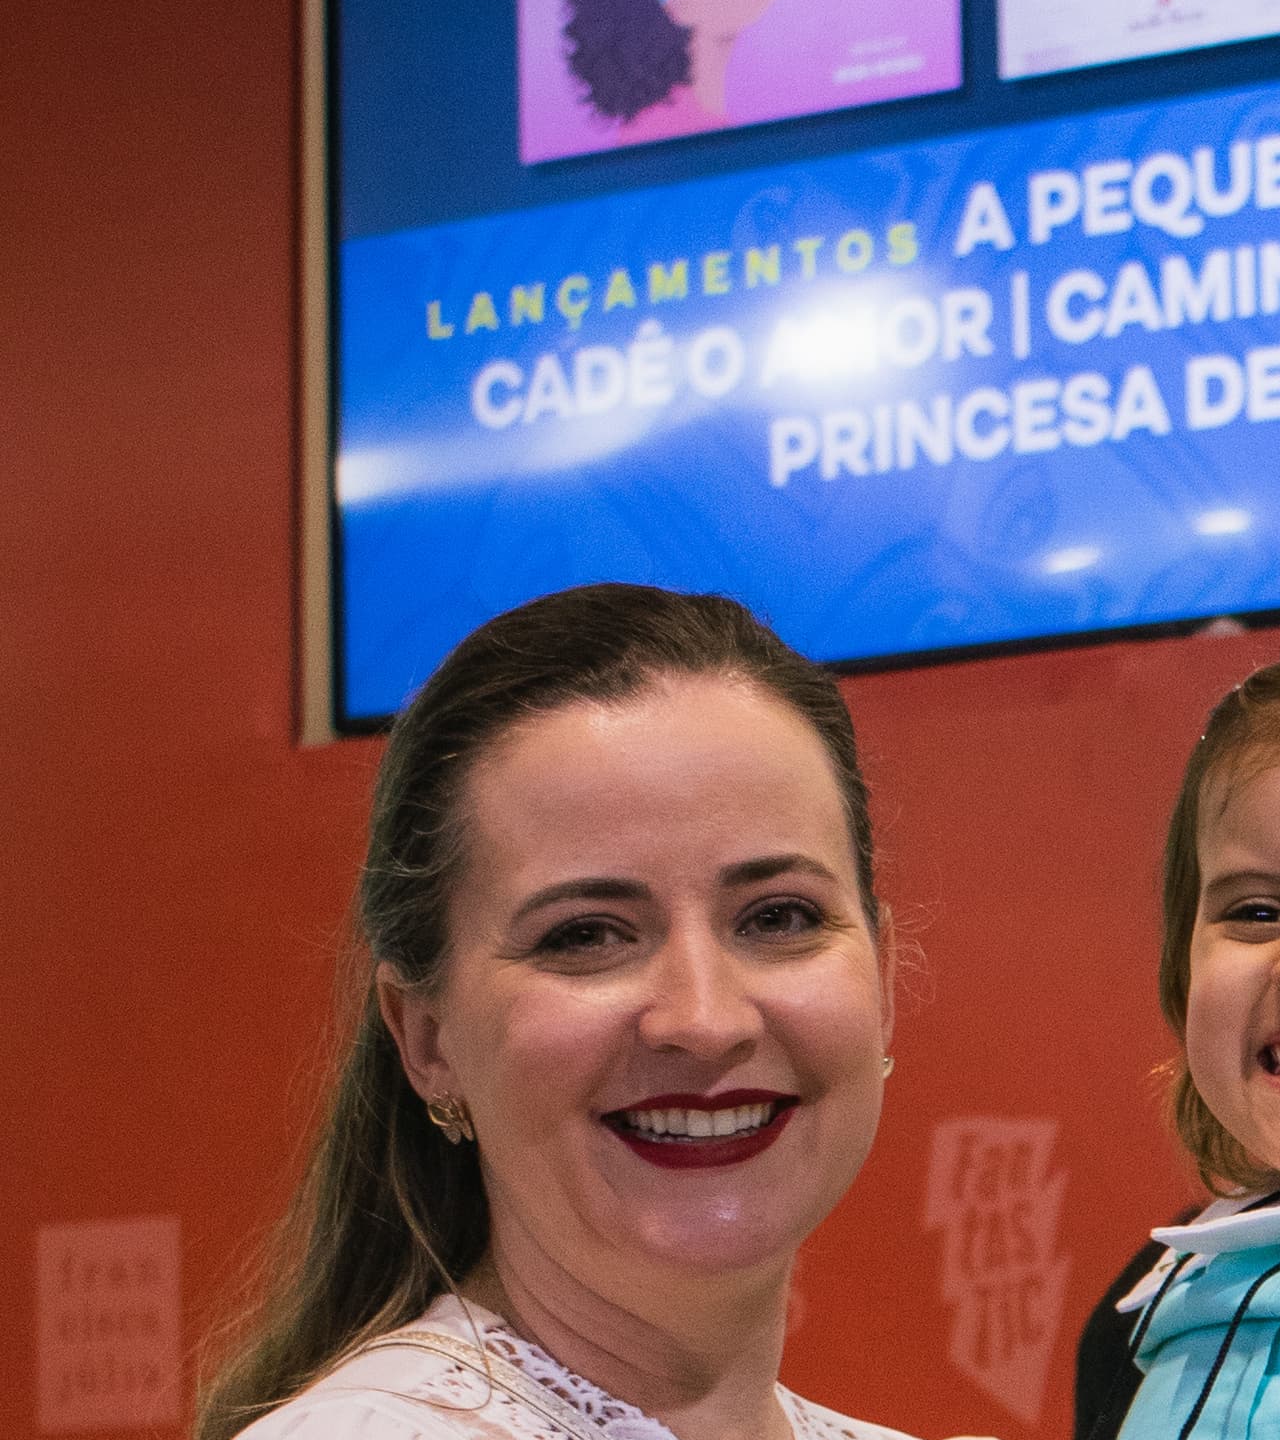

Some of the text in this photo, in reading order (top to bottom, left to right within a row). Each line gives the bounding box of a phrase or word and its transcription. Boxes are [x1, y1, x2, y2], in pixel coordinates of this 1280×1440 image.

[426, 223, 919, 340] LANÇAMENTOS
[955, 181, 1015, 258] A
[470, 318, 675, 429] CADÊ
[687, 327, 746, 399] O
[768, 367, 1172, 489] PRINCESA
